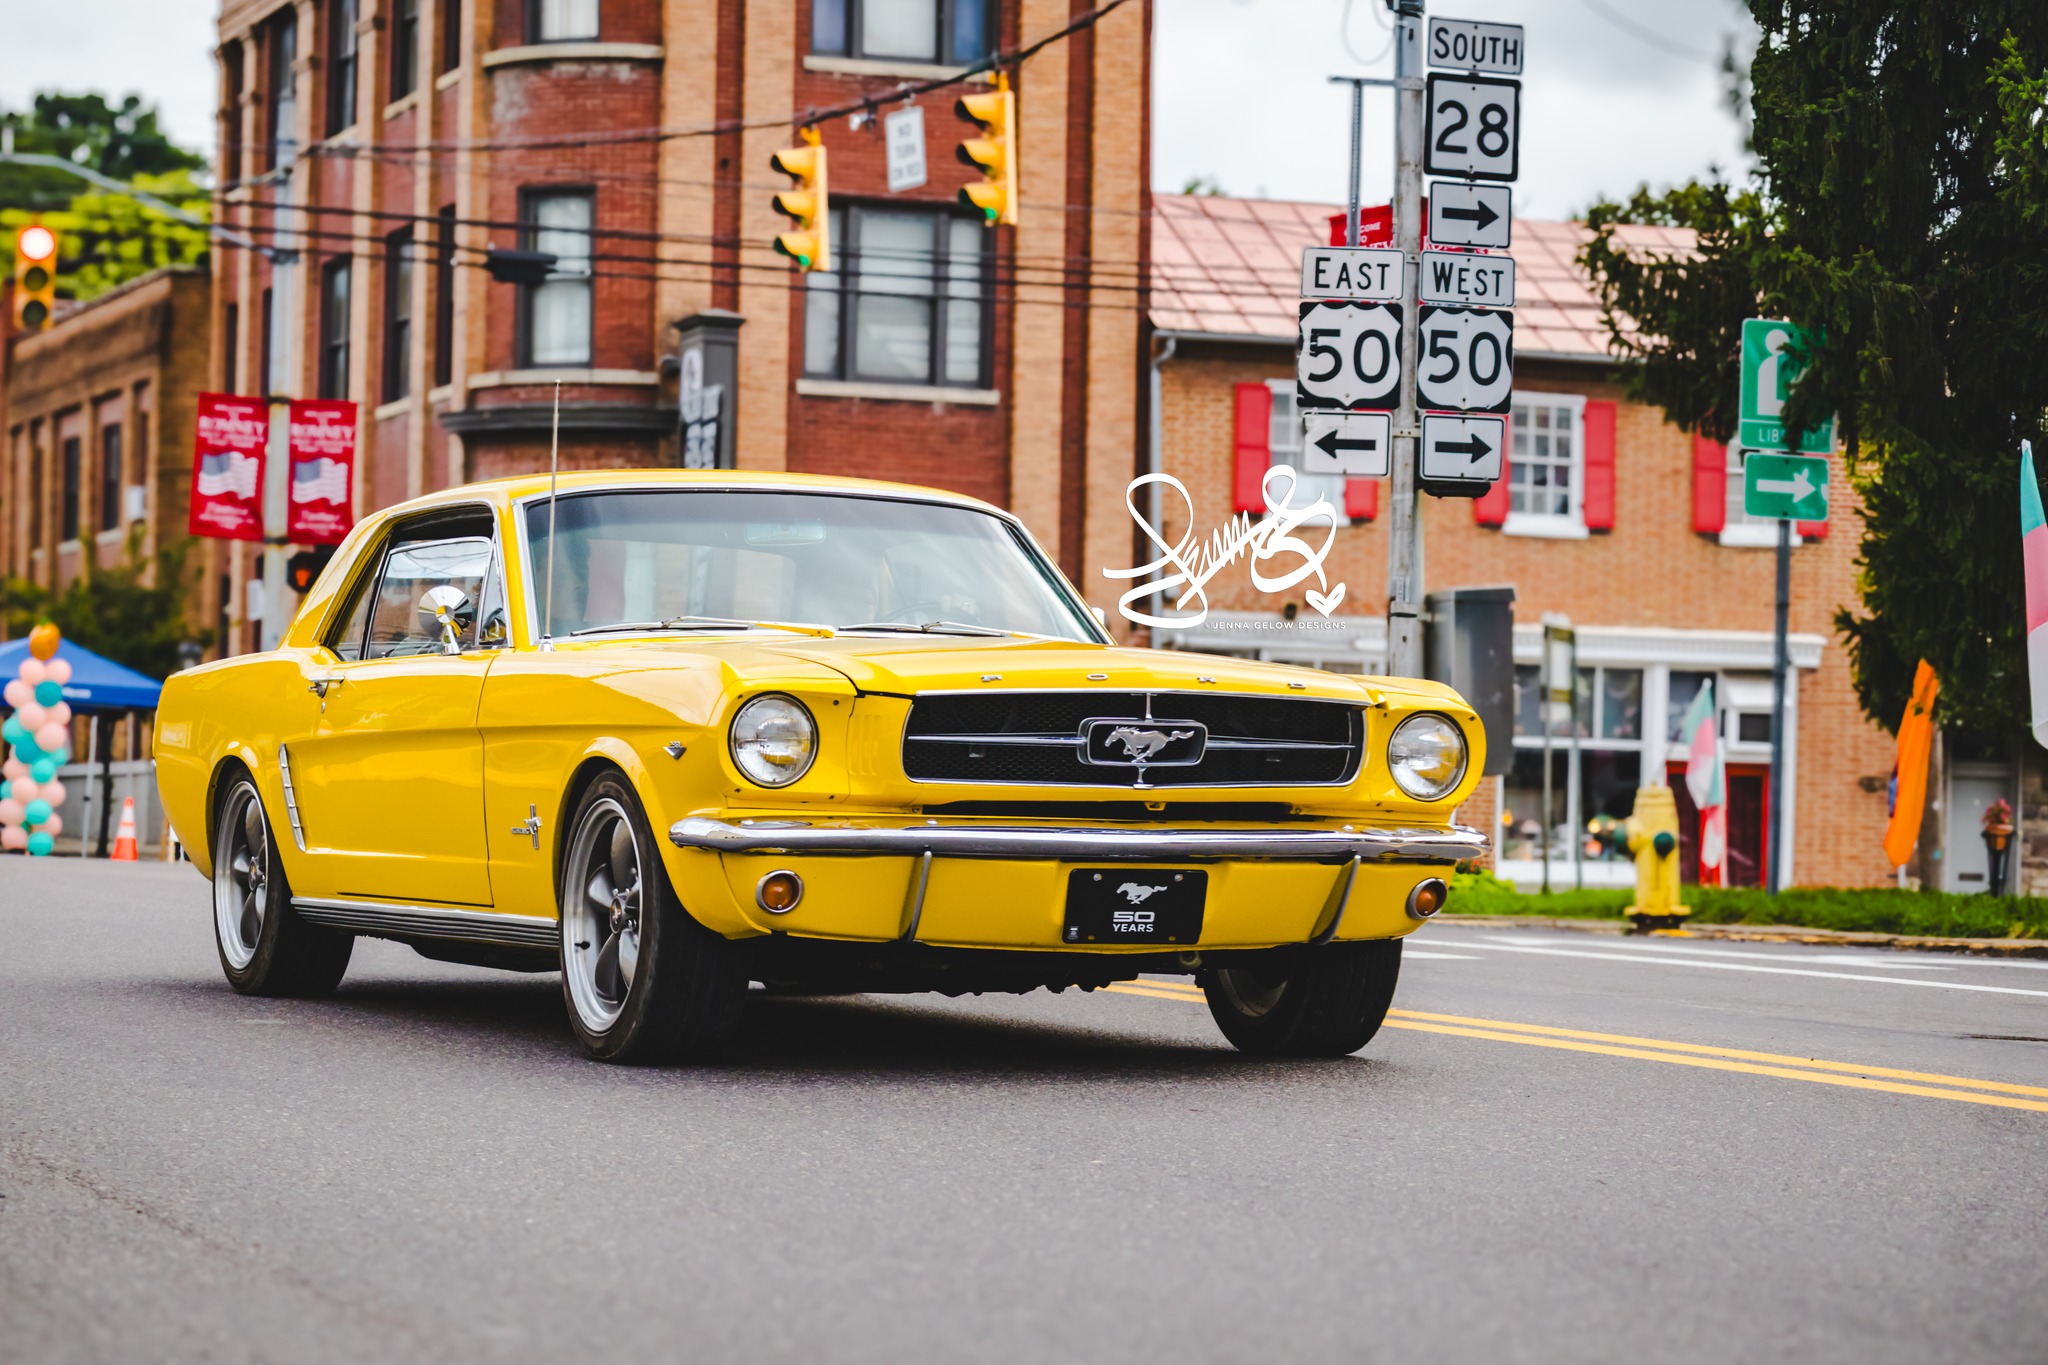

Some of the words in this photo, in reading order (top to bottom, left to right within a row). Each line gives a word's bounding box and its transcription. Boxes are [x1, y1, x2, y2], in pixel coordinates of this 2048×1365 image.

[1434, 27, 1518, 66] SOUTH
[1436, 100, 1509, 158] 28
[1314, 257, 1391, 291] EAST
[1432, 261, 1504, 297] WEST
[1307, 328, 1390, 385] 50
[1428, 330, 1502, 387] 50
[1112, 911, 1155, 923] 50
[1112, 923, 1154, 932] YEARS
